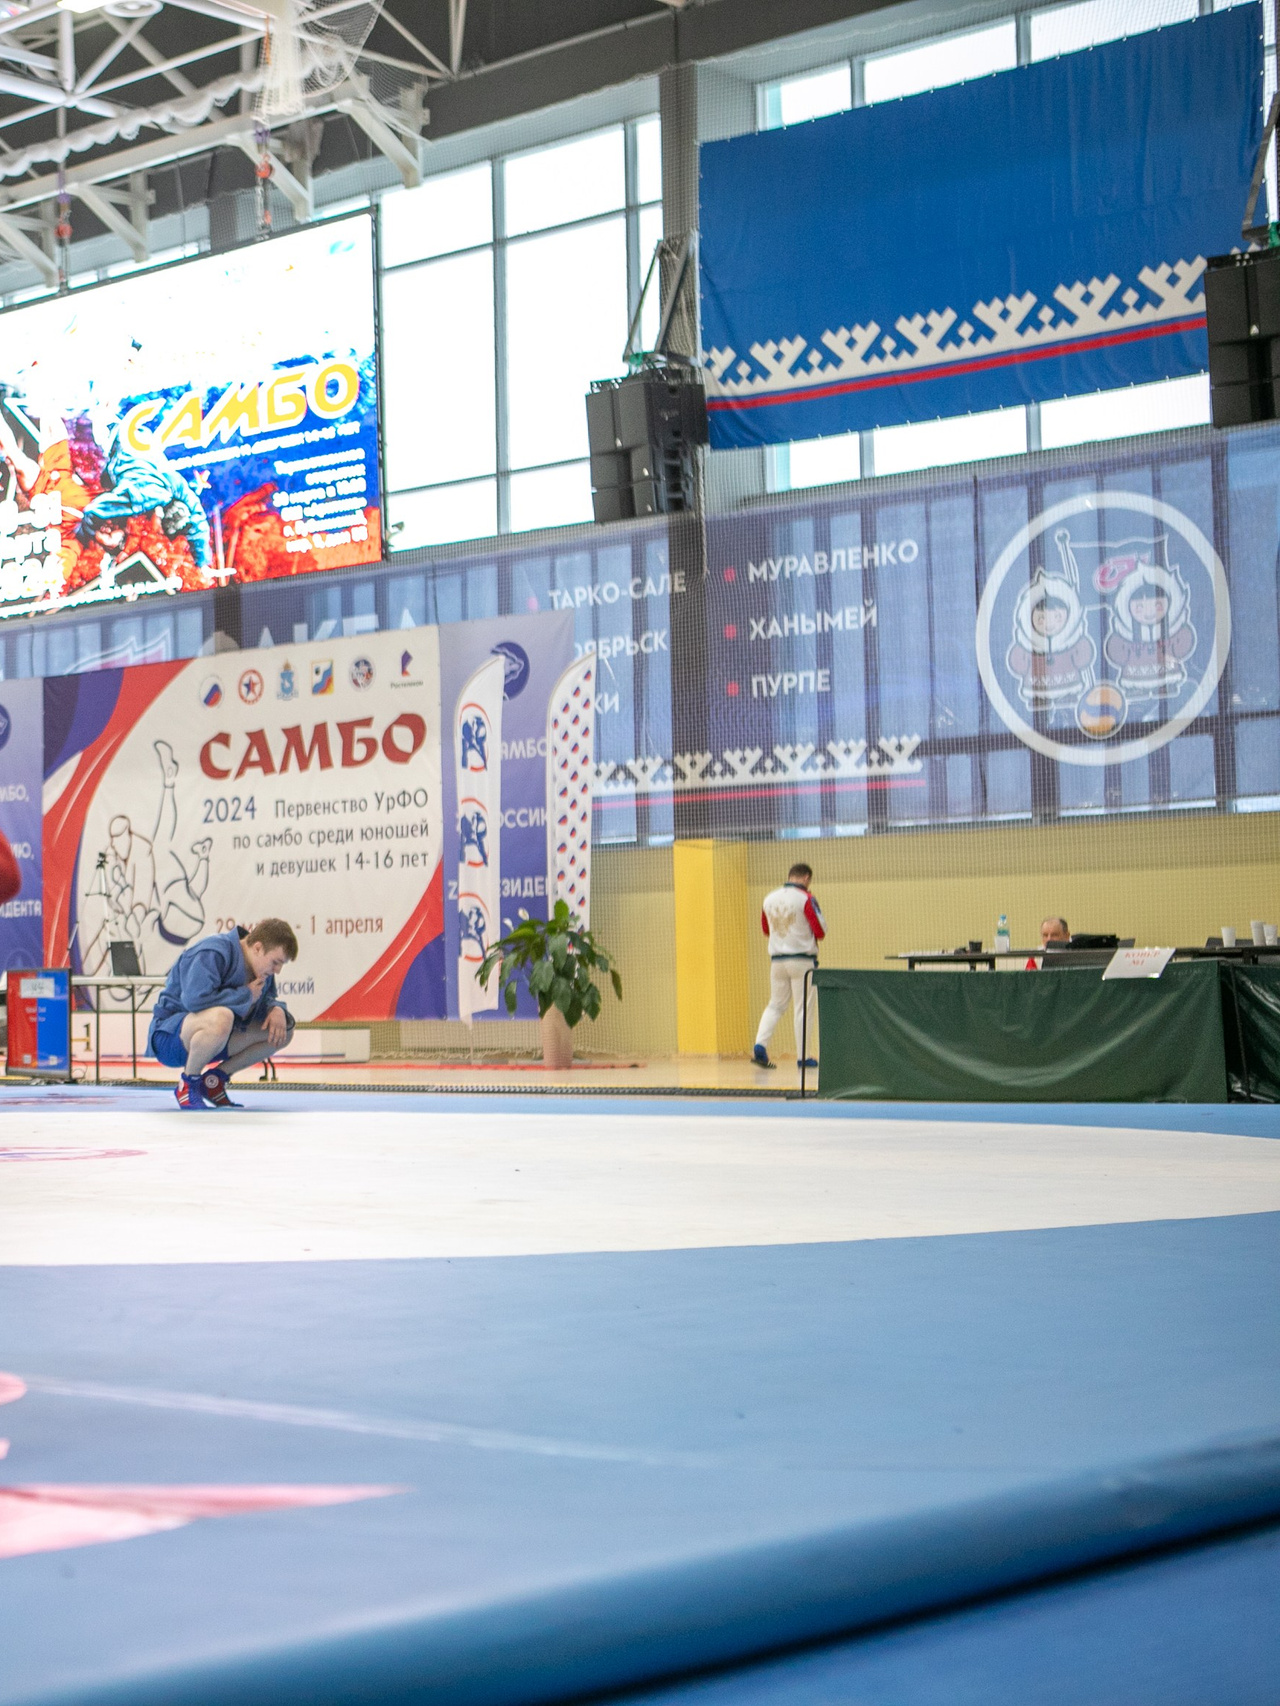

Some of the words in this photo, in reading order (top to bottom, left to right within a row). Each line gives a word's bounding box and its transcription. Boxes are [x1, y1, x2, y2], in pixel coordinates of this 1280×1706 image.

[126, 361, 361, 452] САМБО
[748, 538, 919, 584] МУРАВЛЕНКО
[548, 570, 687, 611] ТАРКО-САЛЕ
[750, 599, 878, 641] ХАНЫМЕЙ
[751, 668, 831, 699] ПУРПЕ
[200, 713, 428, 781] САМБО
[203, 796, 257, 824] 2024
[274, 798, 368, 820] Первенство
[374, 788, 429, 813] УрФО
[233, 834, 251, 850] по
[257, 828, 303, 849] самбо
[308, 828, 354, 847] среди
[360, 820, 429, 842] юношей
[256, 862, 265, 876] и
[270, 858, 336, 878] девушек
[345, 850, 394, 871] 14-16
[400, 852, 429, 869] лет
[311, 915, 317, 935] 1
[325, 917, 384, 937] апреля
